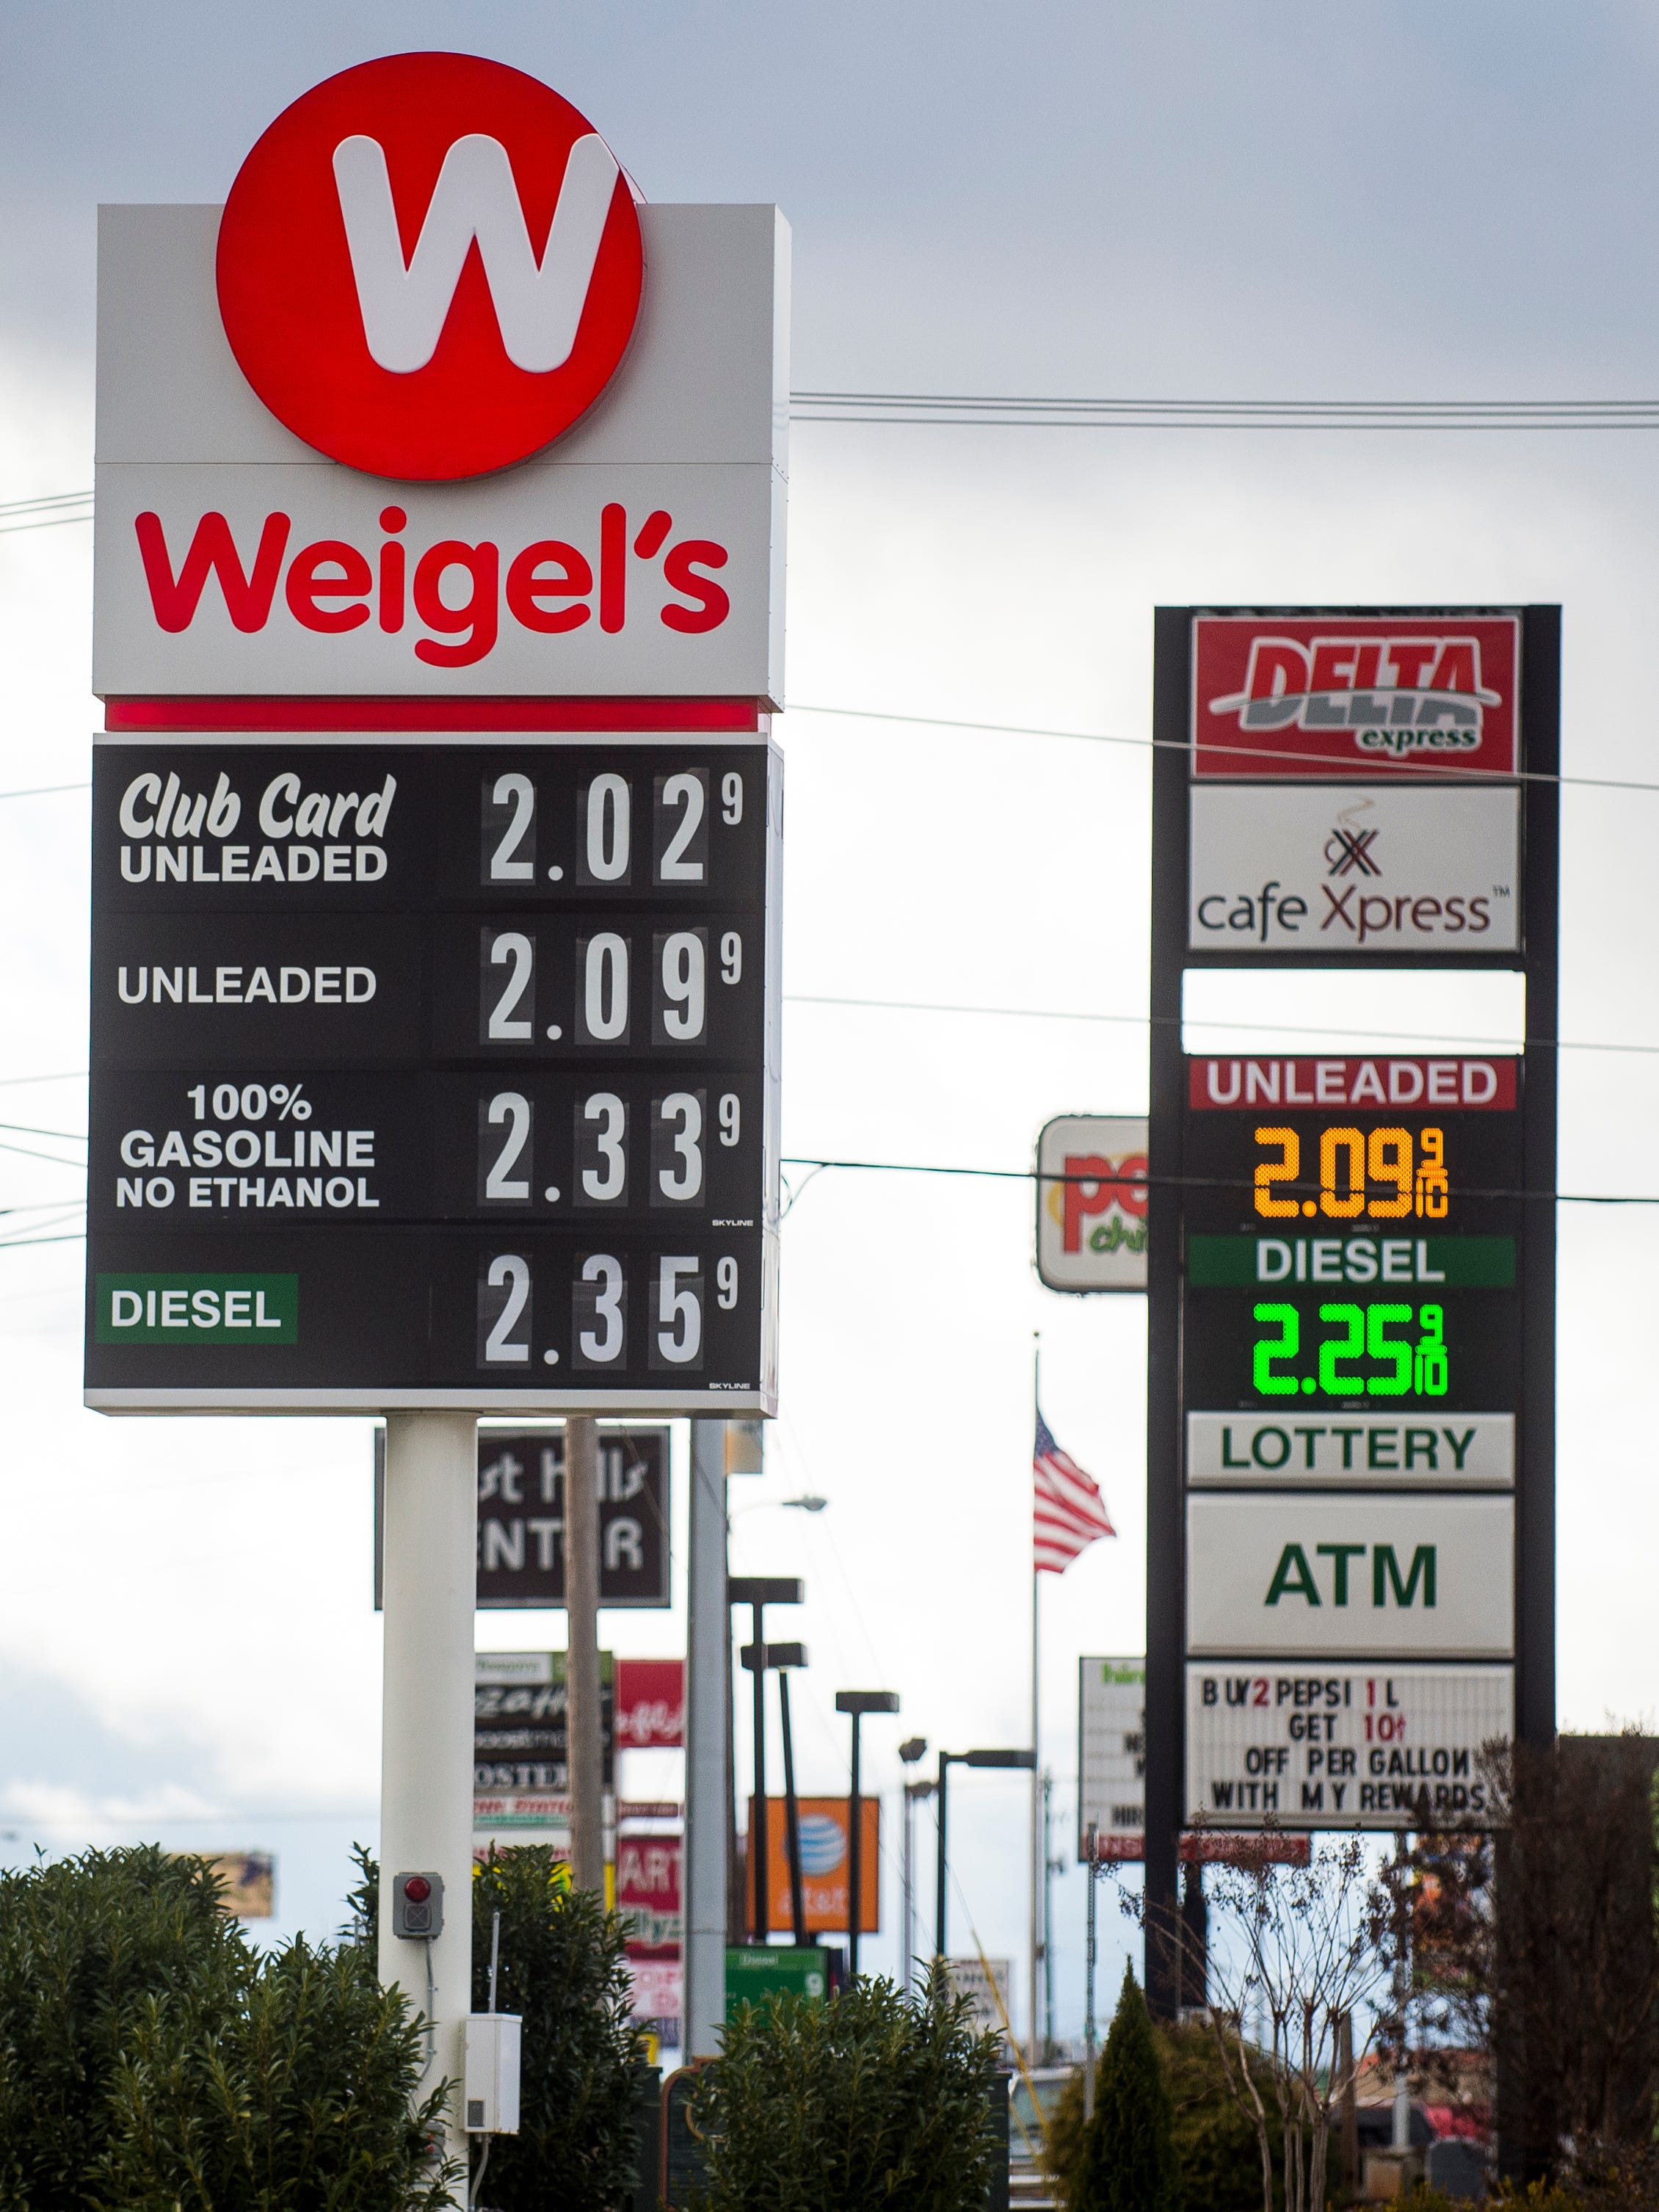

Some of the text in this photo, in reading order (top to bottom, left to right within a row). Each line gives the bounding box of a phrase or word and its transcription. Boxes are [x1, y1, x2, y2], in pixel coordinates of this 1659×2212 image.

[333, 133, 620, 374] W
[135, 503, 730, 668] Weigel's
[1241, 637, 1483, 729] DELTA
[1360, 726, 1477, 753] express
[119, 771, 397, 839] Club Card
[119, 845, 388, 882] UNLEADED
[1198, 882, 1308, 942] cafe
[1320, 884, 1490, 943] Xpress
[117, 967, 377, 1004] UNLEADED
[1207, 1061, 1498, 1104] UNLEADED
[186, 1084, 312, 1121] 100%
[120, 1129, 376, 1168] GASOLINE
[117, 1176, 380, 1208] NO ETHANOL
[1257, 1239, 1445, 1282] DIESEL
[112, 1290, 281, 1328] DIESEL
[1222, 1427, 1476, 1470] LOTTERY
[1264, 1544, 1437, 1607] ATM
[1277, 1678, 1351, 1707] PEPSI
[1290, 1714, 1337, 1741] GET
[1246, 1748, 1469, 1777] OFF PER GALLON
[1212, 1783, 1279, 1810] WITH
[1302, 1783, 1344, 1810] MY
